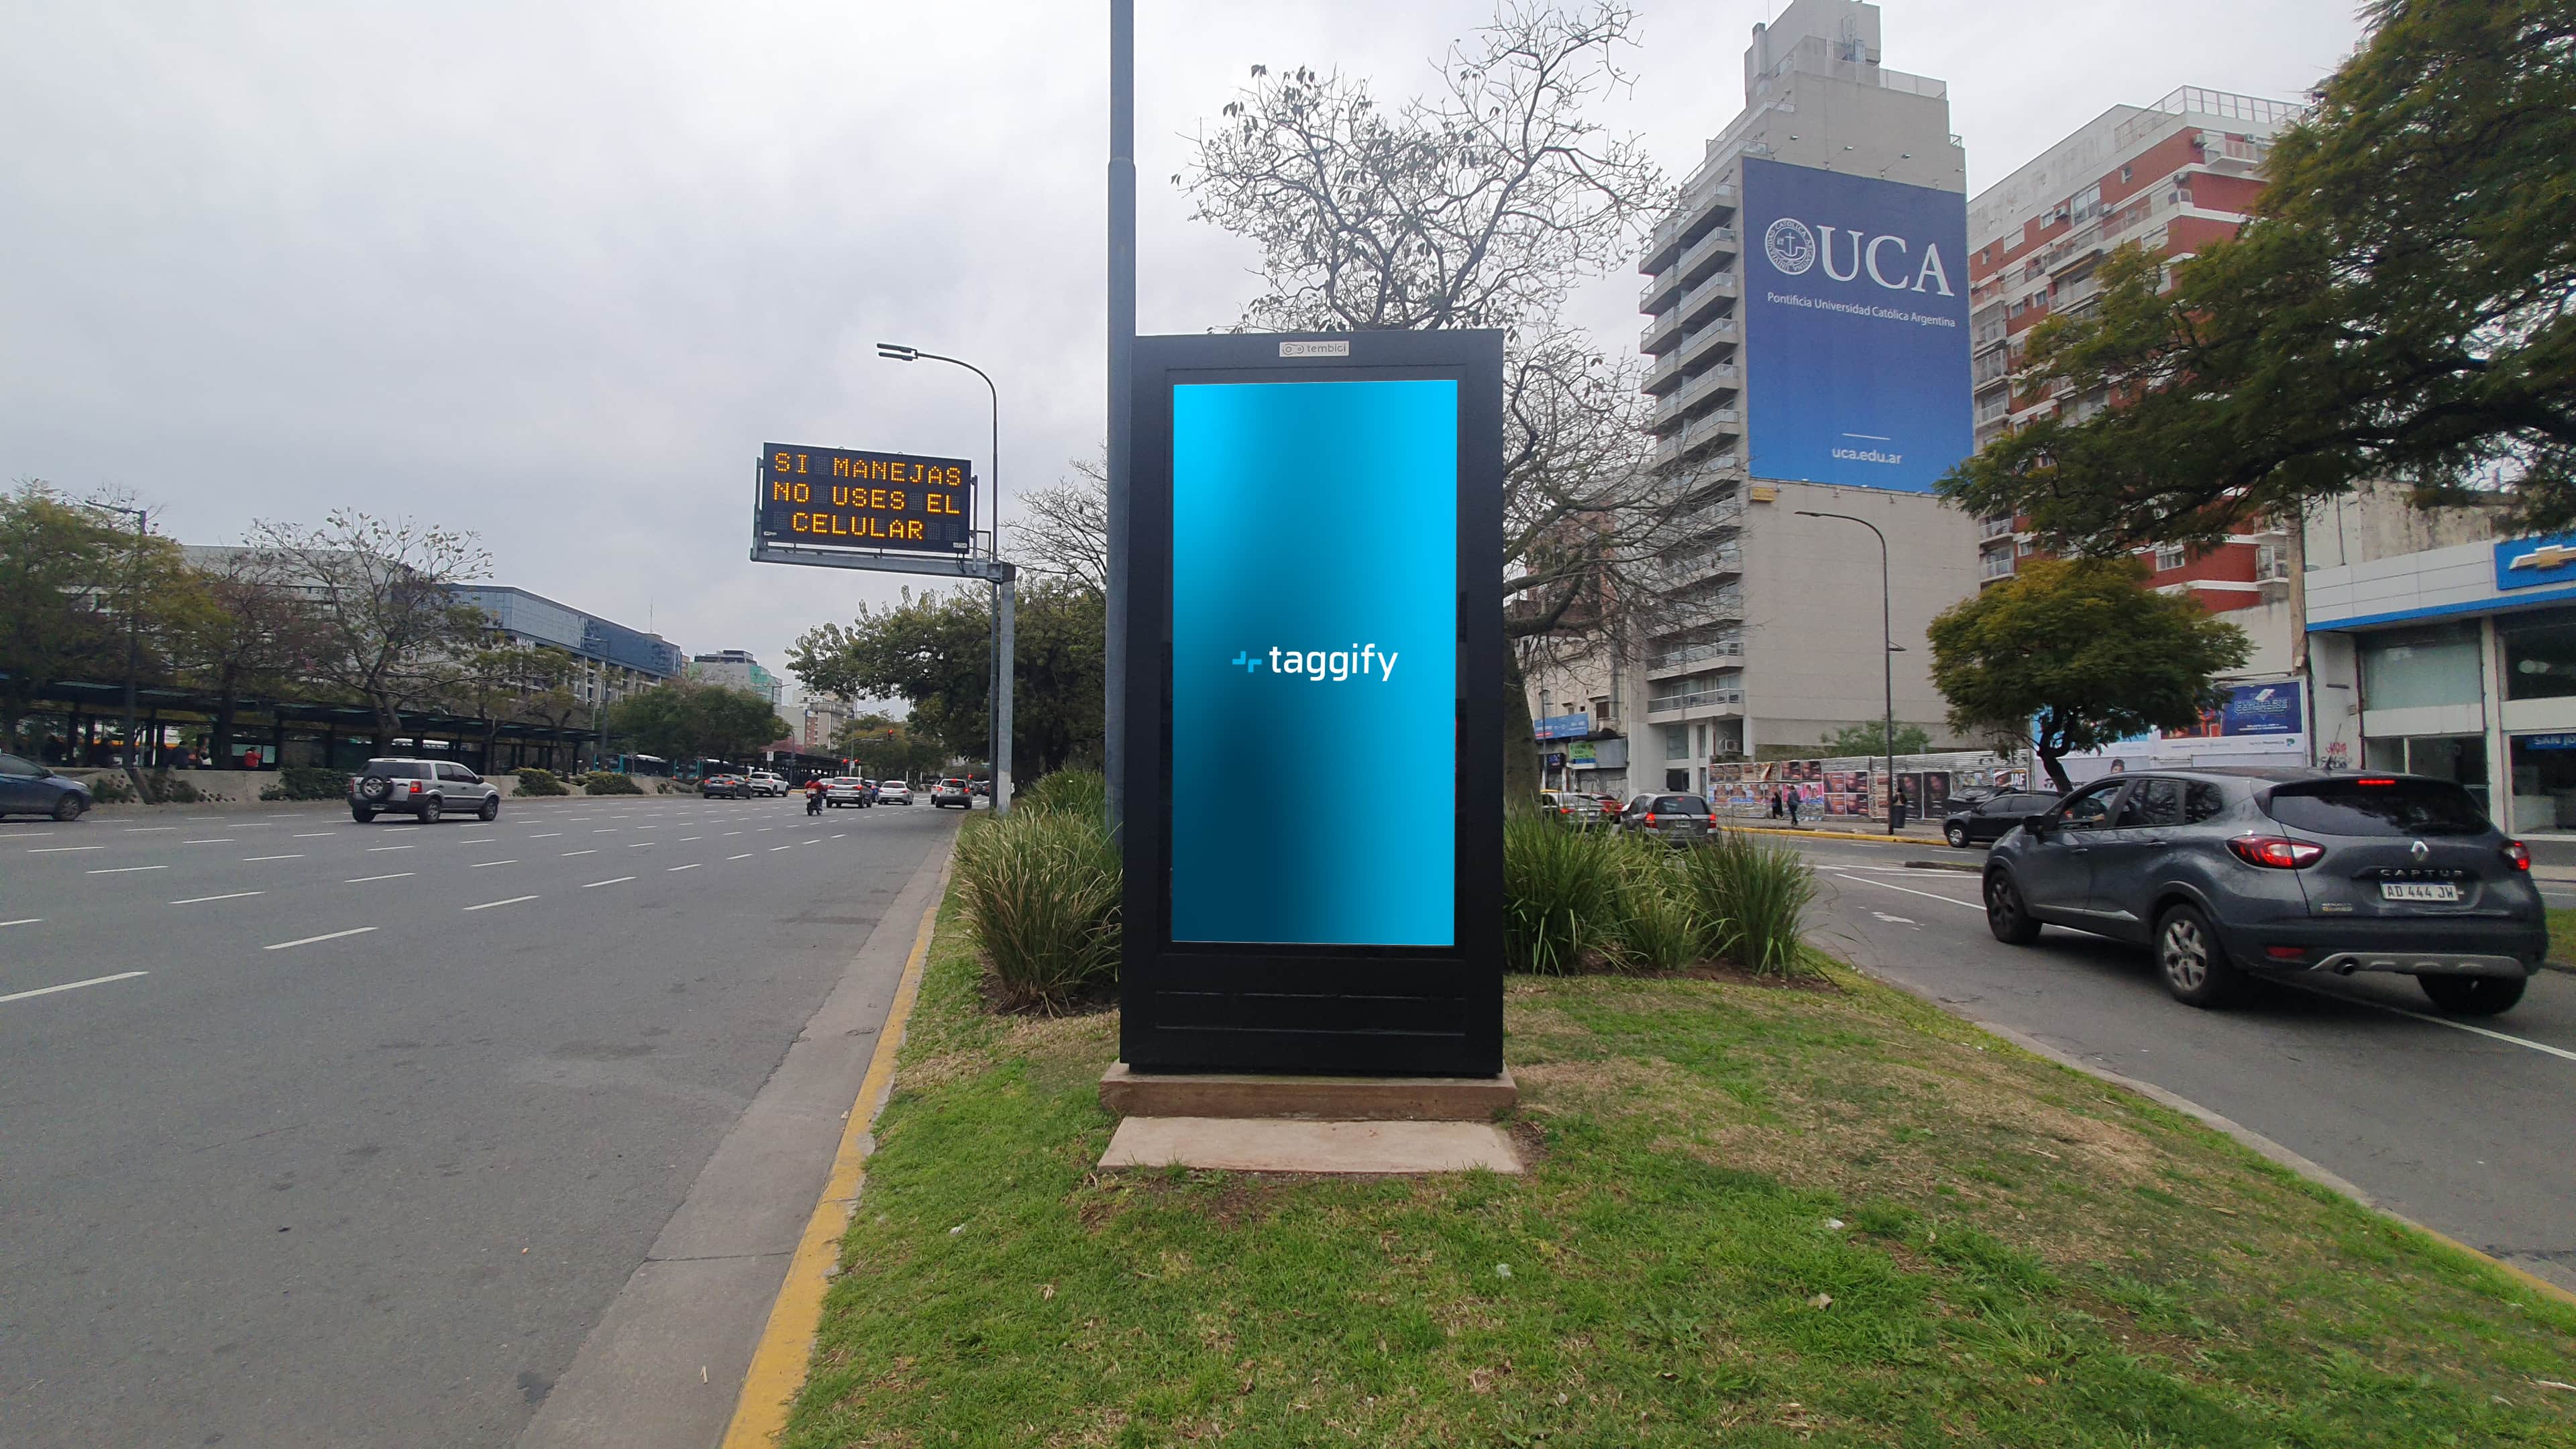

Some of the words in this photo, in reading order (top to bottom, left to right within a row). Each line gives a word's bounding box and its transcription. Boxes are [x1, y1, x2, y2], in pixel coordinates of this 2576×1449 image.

[1817, 225, 1955, 297] UCA
[1768, 292, 1812, 308] Pontificia
[1815, 299, 1870, 316] Universidad
[1872, 307, 1909, 321] Católica
[1911, 312, 1956, 328] Argentina
[1307, 342, 1346, 354] tembici
[774, 451, 808, 474] SI
[833, 457, 961, 487] MANEJAS
[1831, 447, 1902, 465] uca.edu.ar
[773, 481, 810, 503] NO
[833, 486, 906, 511] USES
[927, 493, 960, 515] EL
[792, 512, 924, 540] CELULAR
[1269, 643, 1399, 682] taggify
[2533, 735, 2561, 745] SAN
[2380, 869, 2464, 877] CAPTUR
[2387, 885, 2403, 897] AD
[2408, 886, 2432, 898] 444
[2437, 886, 2455, 898] JW
